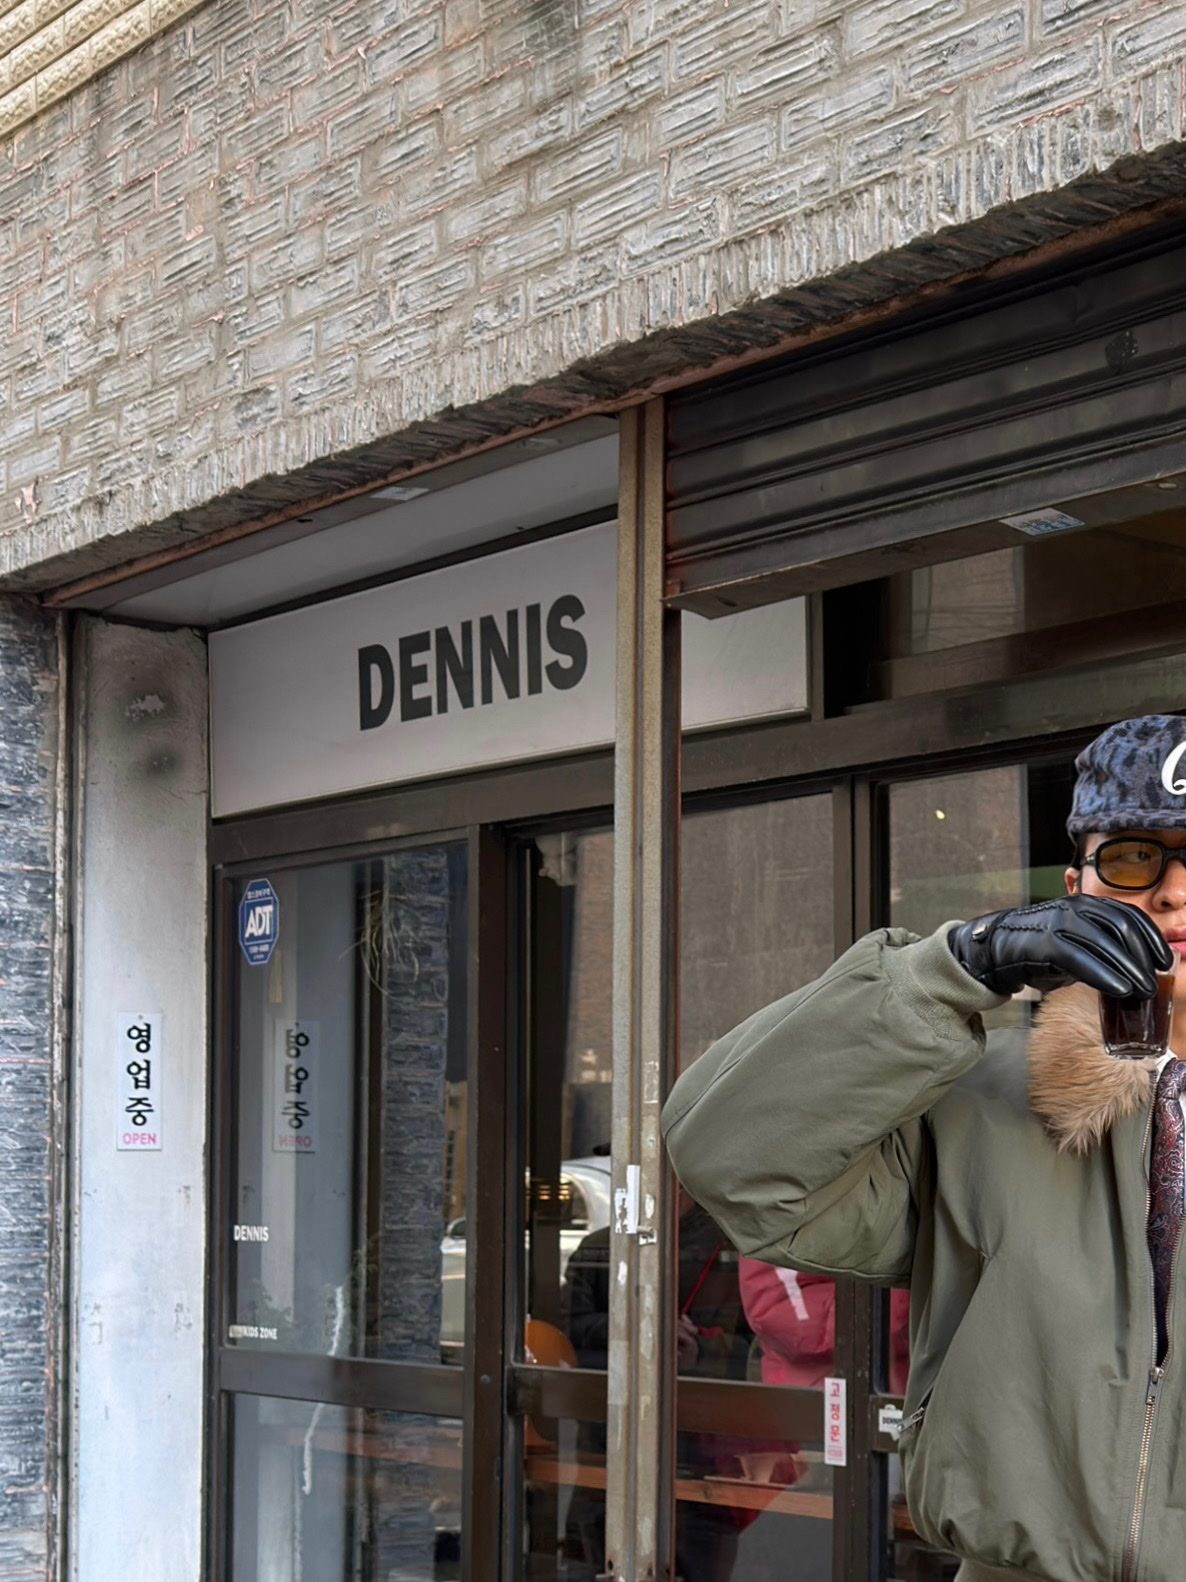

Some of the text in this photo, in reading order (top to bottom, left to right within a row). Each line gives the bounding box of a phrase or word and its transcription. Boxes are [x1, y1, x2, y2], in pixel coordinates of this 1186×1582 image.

[358, 594, 588, 731] DENNIS
[244, 905, 273, 938] ADT
[125, 1022, 155, 1127] 영업중
[122, 1132, 156, 1146] OPEN
[234, 1225, 269, 1241] DENNIS
[260, 1327, 278, 1340] ZONE
[830, 1382, 841, 1443] 고정문
